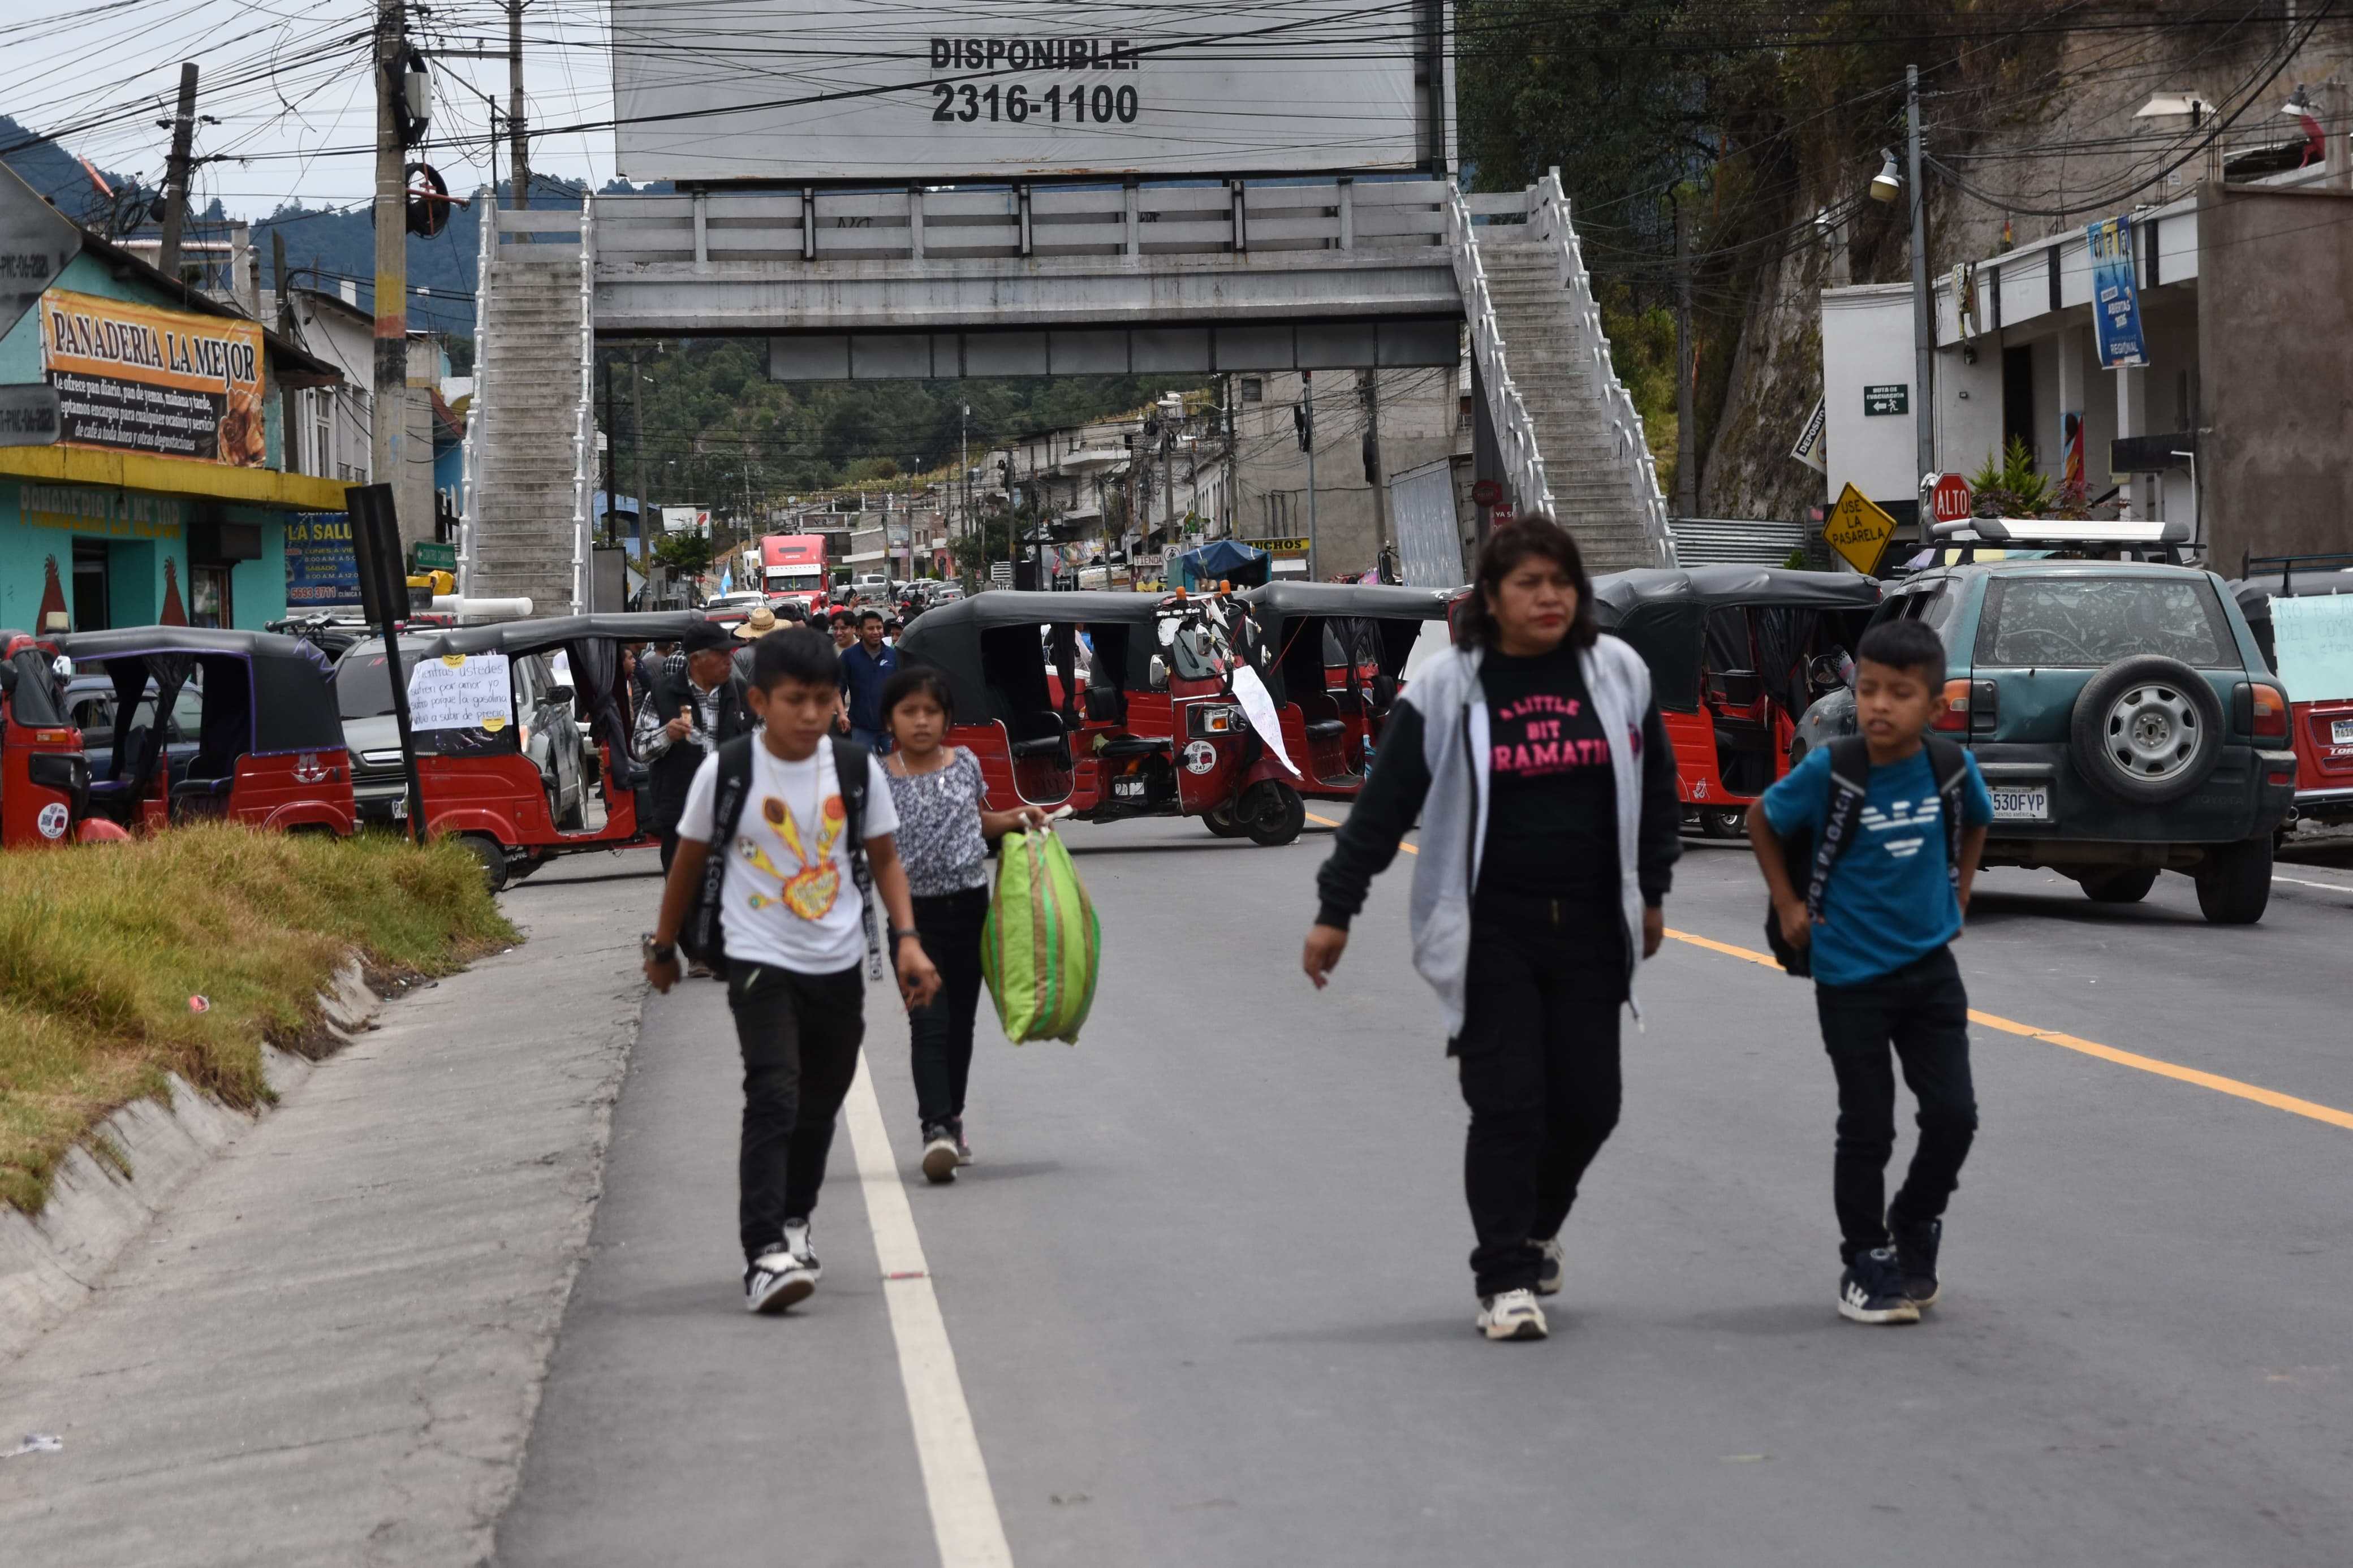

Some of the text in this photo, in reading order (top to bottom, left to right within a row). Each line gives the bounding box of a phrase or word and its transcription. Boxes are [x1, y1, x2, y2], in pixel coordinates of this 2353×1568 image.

[932, 83, 1138, 123] 2316-1100
[52, 311, 256, 390] PANADERIA LA MEJOR
[64, 373, 86, 392] ofrece
[87, 381, 100, 399] pan
[101, 378, 123, 401] diario,
[123, 386, 136, 404] pan
[136, 383, 144, 400] de
[165, 390, 189, 407] mañana
[188, 397, 193, 413] y
[193, 394, 213, 414] tarde,
[91, 404, 119, 424] encargos
[120, 408, 135, 425] para
[136, 407, 165, 429] cualquier
[165, 411, 188, 429] ocasión
[188, 417, 192, 434] y
[192, 415, 216, 431] servicio
[75, 420, 196, 452] de café a toda hora y otras degustaciones
[1841, 499, 1861, 514] USE
[1937, 490, 1967, 516] ALTO
[313, 523, 352, 539] SALU
[1847, 516, 1862, 529] LA
[1833, 527, 1885, 545] PASARELA
[1135, 556, 1163, 565] TIENDA
[291, 586, 336, 599] 5693 3711
[459, 659, 503, 677] ustedes
[411, 679, 499, 696] sufren por amor yo
[431, 696, 456, 708] porque
[459, 690, 469, 705] la
[473, 689, 507, 707] gasolina
[1512, 695, 1580, 717] LITTLE
[439, 707, 458, 721] subir
[463, 708, 471, 720] de
[1526, 719, 1561, 740] BIT
[1492, 738, 1610, 771] RAMATI
[1988, 793, 2045, 811] 530FYP
